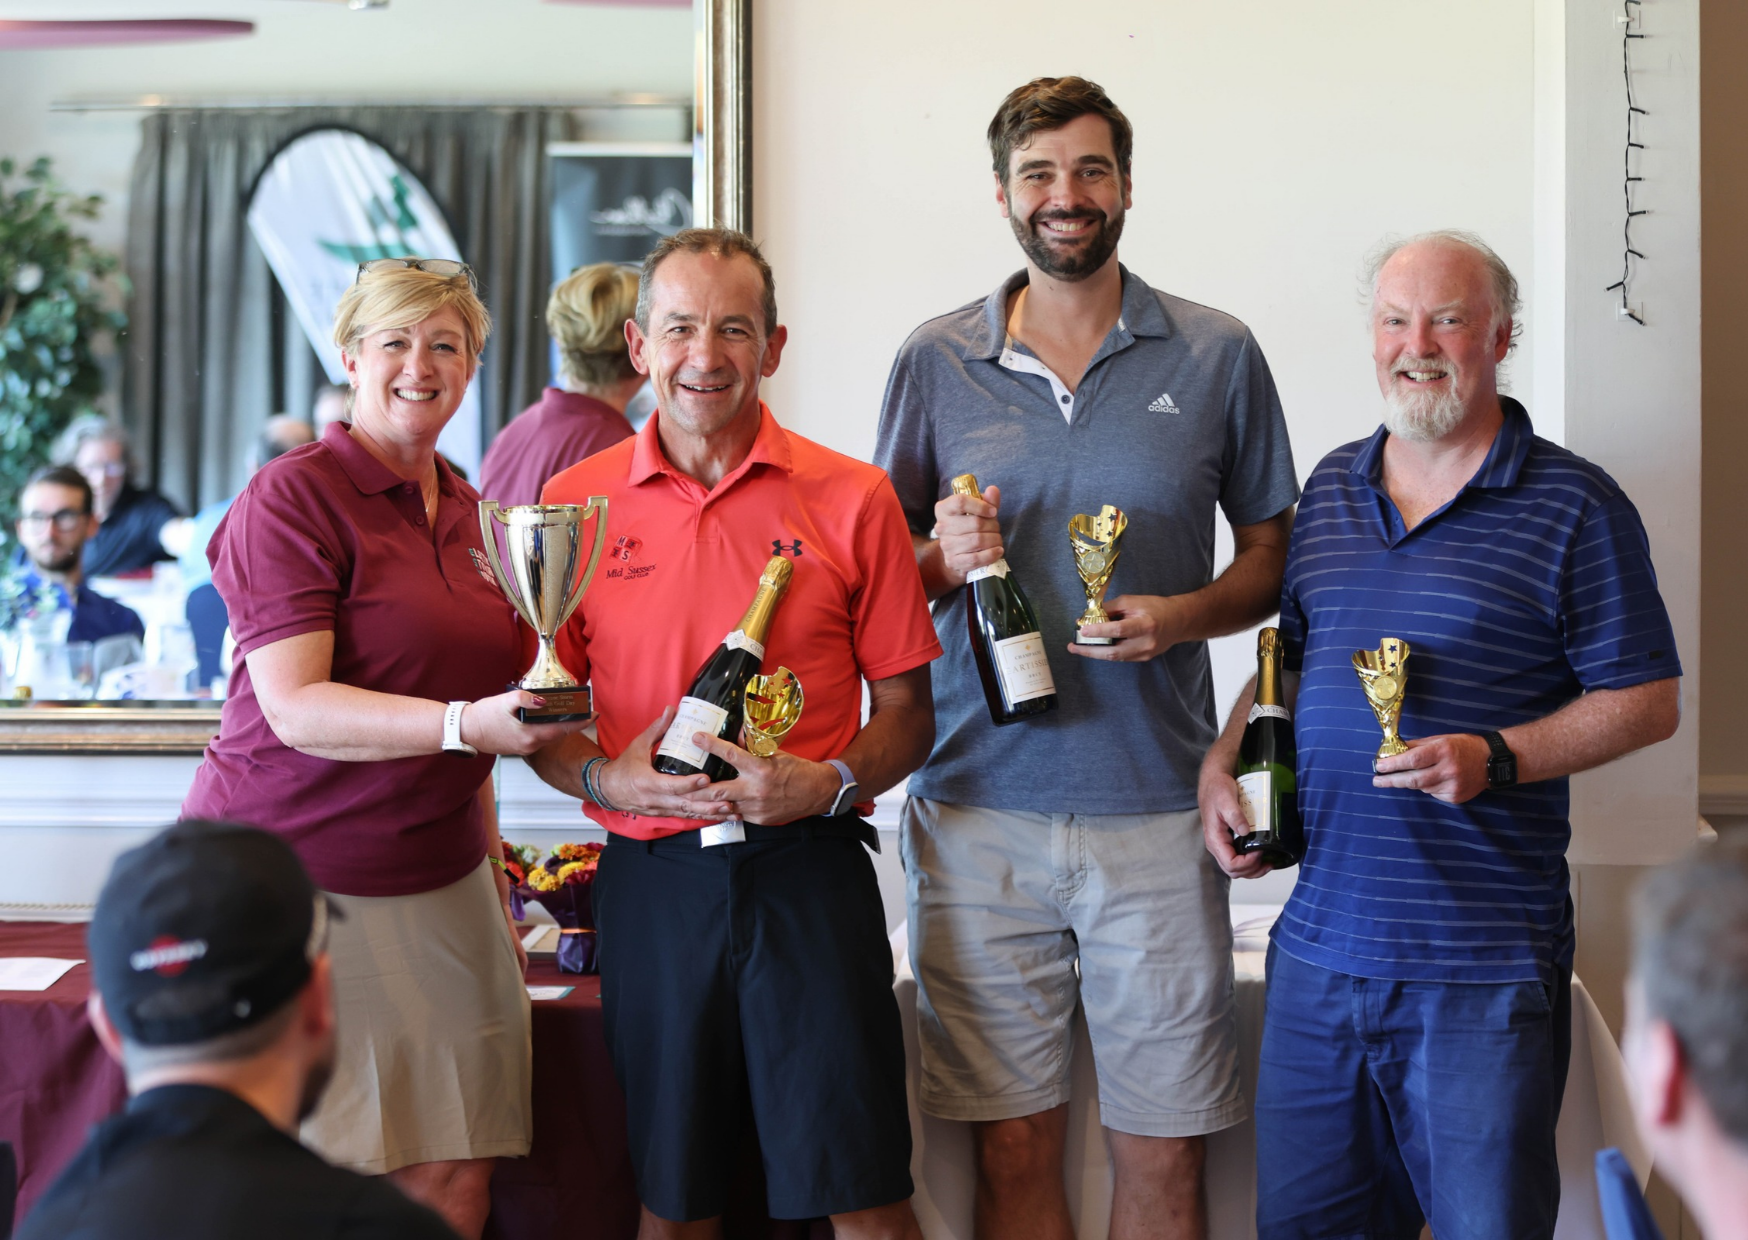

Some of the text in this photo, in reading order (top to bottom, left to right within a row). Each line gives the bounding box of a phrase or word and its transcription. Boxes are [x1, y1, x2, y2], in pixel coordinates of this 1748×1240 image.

[1148, 405, 1180, 415] adidas
[622, 550, 630, 560] S
[606, 567, 624, 579] Mid
[745, 588, 767, 623] CHAMPAGNE
